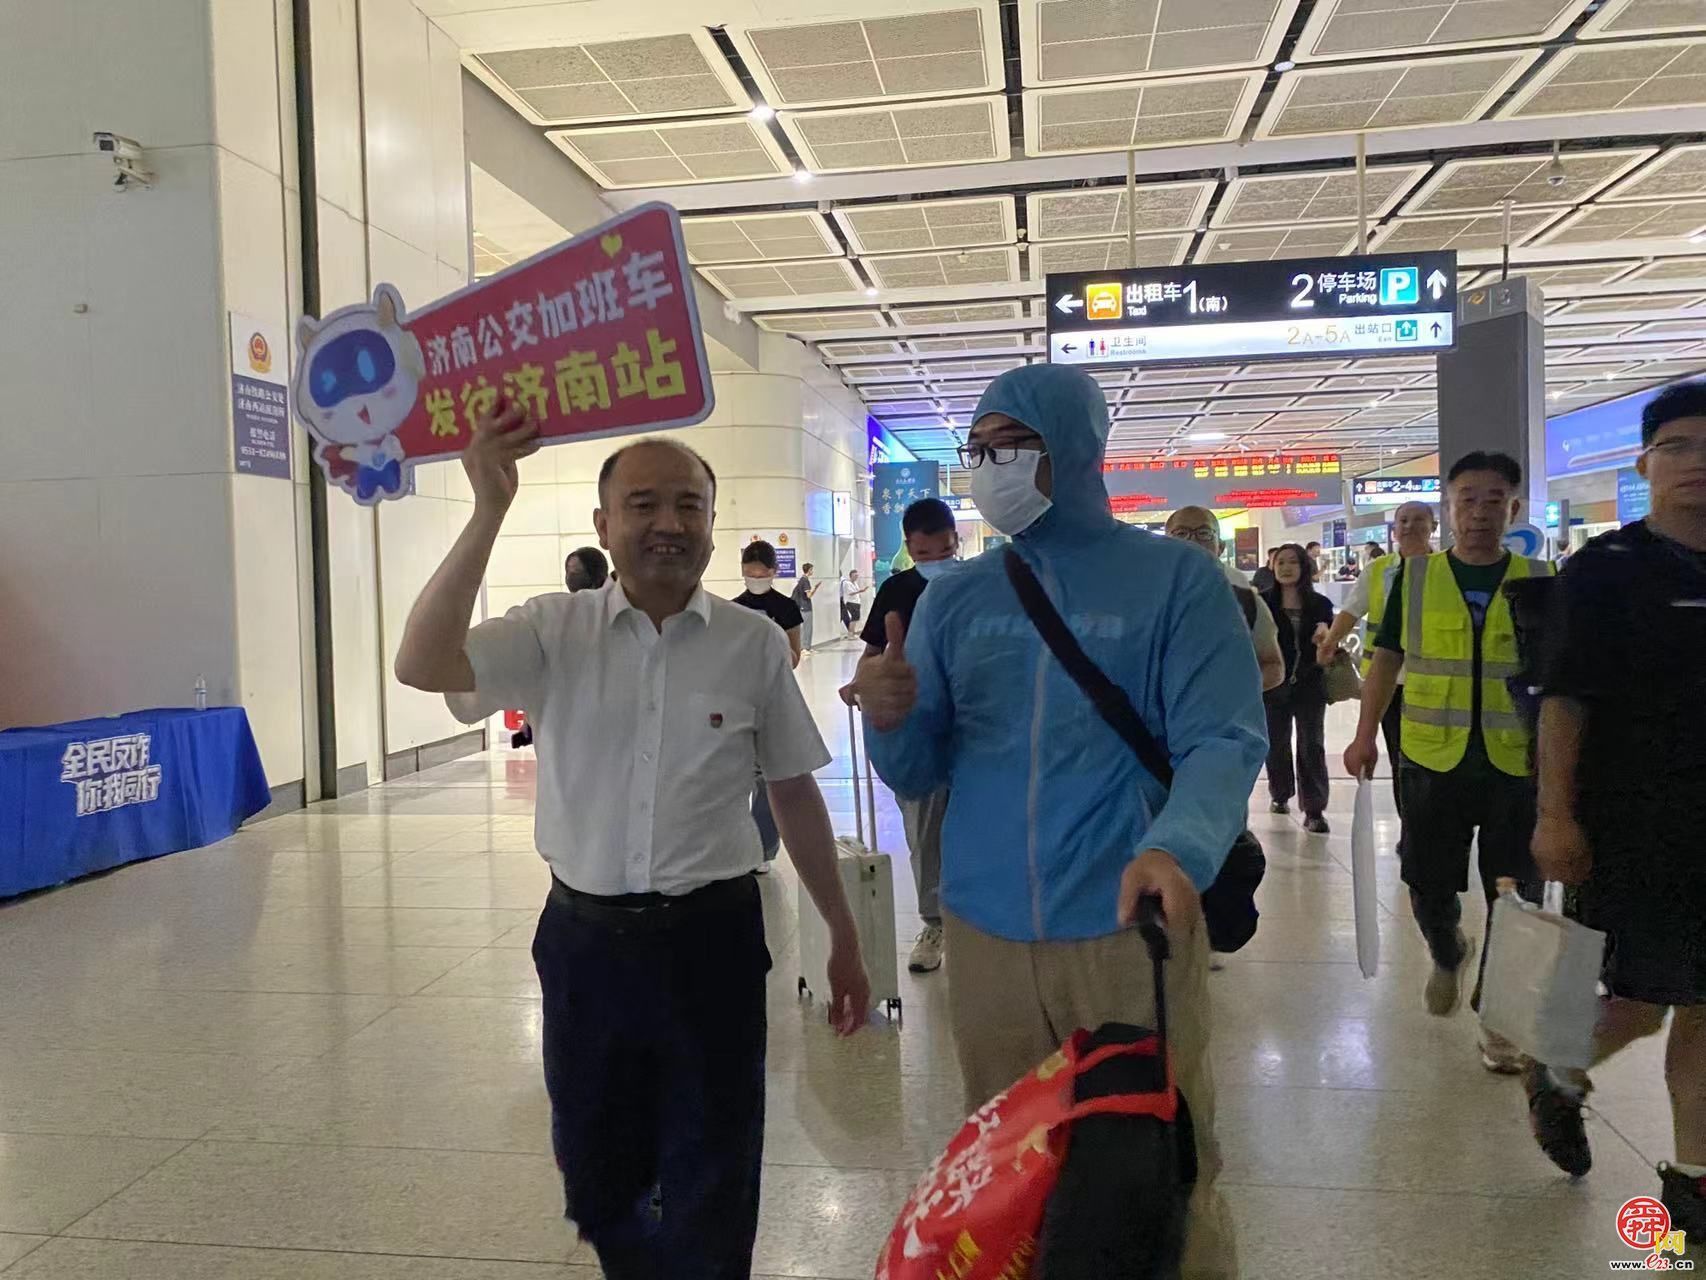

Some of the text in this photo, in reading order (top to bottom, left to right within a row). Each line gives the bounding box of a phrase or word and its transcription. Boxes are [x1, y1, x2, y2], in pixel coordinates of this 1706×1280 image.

[427, 250, 674, 375] 济南公交加班车
[1127, 306, 1147, 317] Taxi
[1339, 293, 1378, 305] Parking
[1110, 335, 1147, 348] 卫生间
[1354, 323, 1393, 335] 出站口
[425, 328, 687, 436] 发往济南站
[61, 734, 151, 780] 全民反诈
[77, 765, 161, 815] 你我同行
